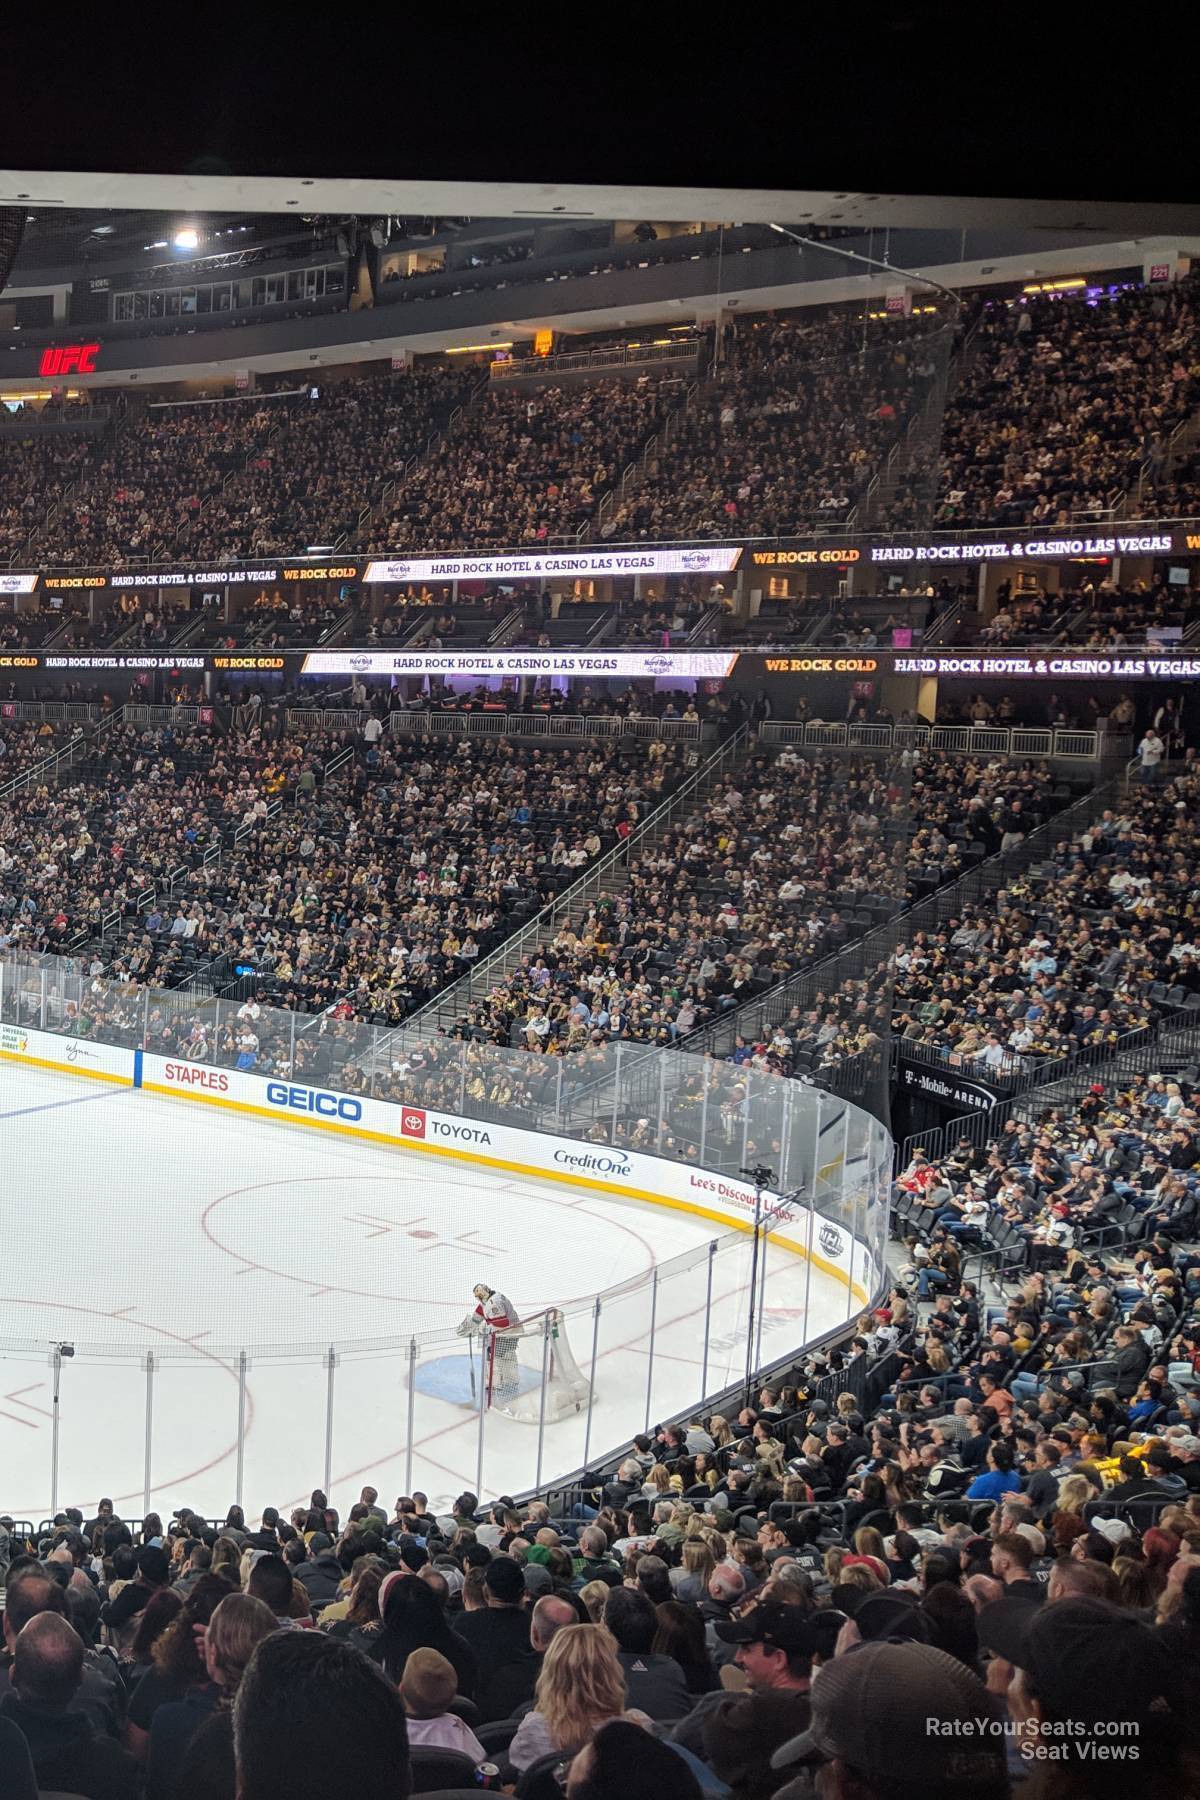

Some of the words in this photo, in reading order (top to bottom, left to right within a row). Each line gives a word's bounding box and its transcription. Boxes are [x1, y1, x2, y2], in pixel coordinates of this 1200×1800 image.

[1152, 268, 1168, 278] 221
[40, 343, 100, 376] UFC
[872, 548, 913, 561] HARD
[916, 546, 959, 559] ROCK
[962, 544, 1009, 557] HOTEL
[1013, 543, 1023, 556] &
[1026, 540, 1082, 555] CASINO
[1085, 539, 1115, 553] LAS
[1118, 537, 1171, 551] VEGAS
[753, 552, 776, 564] WE
[778, 551, 817, 563] ROCK
[820, 550, 859, 562] GOLD
[432, 564, 460, 574] HARD
[463, 562, 492, 573] ROCK
[496, 561, 531, 572] HOTEL
[534, 560, 542, 571] &
[545, 559, 587, 570] CASINO
[591, 558, 612, 569] LAS
[616, 557, 654, 568] VEGAS
[112, 577, 133, 586] HARD
[135, 576, 157, 585] ROCK
[159, 574, 185, 584] HOTEL
[187, 574, 193, 583] &
[195, 572, 227, 582] CASINO
[229, 572, 245, 581] LAS
[247, 570, 276, 580] VEGAS
[284, 570, 299, 579] WE
[300, 569, 326, 578] ROCK
[329, 568, 356, 578] GOLD
[45, 579, 59, 587] WE
[61, 579, 83, 587] ROCK
[84, 578, 105, 587] GOLD
[14, 657, 37, 666] GOLD
[46, 658, 67, 667] HARD
[69, 658, 90, 667] ROCK
[92, 658, 117, 667] HOTEL
[119, 658, 125, 667] &
[127, 658, 156, 667] CASINO
[158, 658, 174, 667] LAS
[176, 658, 204, 667] VEGAS
[214, 658, 229, 667] WE
[230, 658, 256, 667] ROCK
[258, 658, 284, 667] GOLD
[394, 659, 422, 668] HARD
[425, 659, 455, 668] ROCK
[458, 659, 493, 668] HOTEL
[498, 659, 505, 668] &
[508, 659, 550, 668] CASINO
[554, 659, 575, 669] LAS
[579, 659, 617, 669] VEGAS
[766, 660, 789, 670] WE
[791, 660, 832, 670] ROCK
[835, 660, 876, 671] GOLD
[895, 659, 936, 672] HARD
[939, 659, 980, 672] ROCK
[983, 659, 1031, 672] HOTEL
[1036, 660, 1046, 673] &
[1050, 660, 1110, 673] CASINO
[1113, 660, 1146, 673] LAS
[1147, 661, 1200, 674] VEGAS
[165, 1064, 228, 1091] STAPLES
[266, 1082, 362, 1122] GEICO
[954, 1090, 988, 1110] ARENA
[431, 1121, 491, 1145] TOYOTA
[690, 1175, 716, 1192] Lee's
[819, 1230, 844, 1250] NHL
